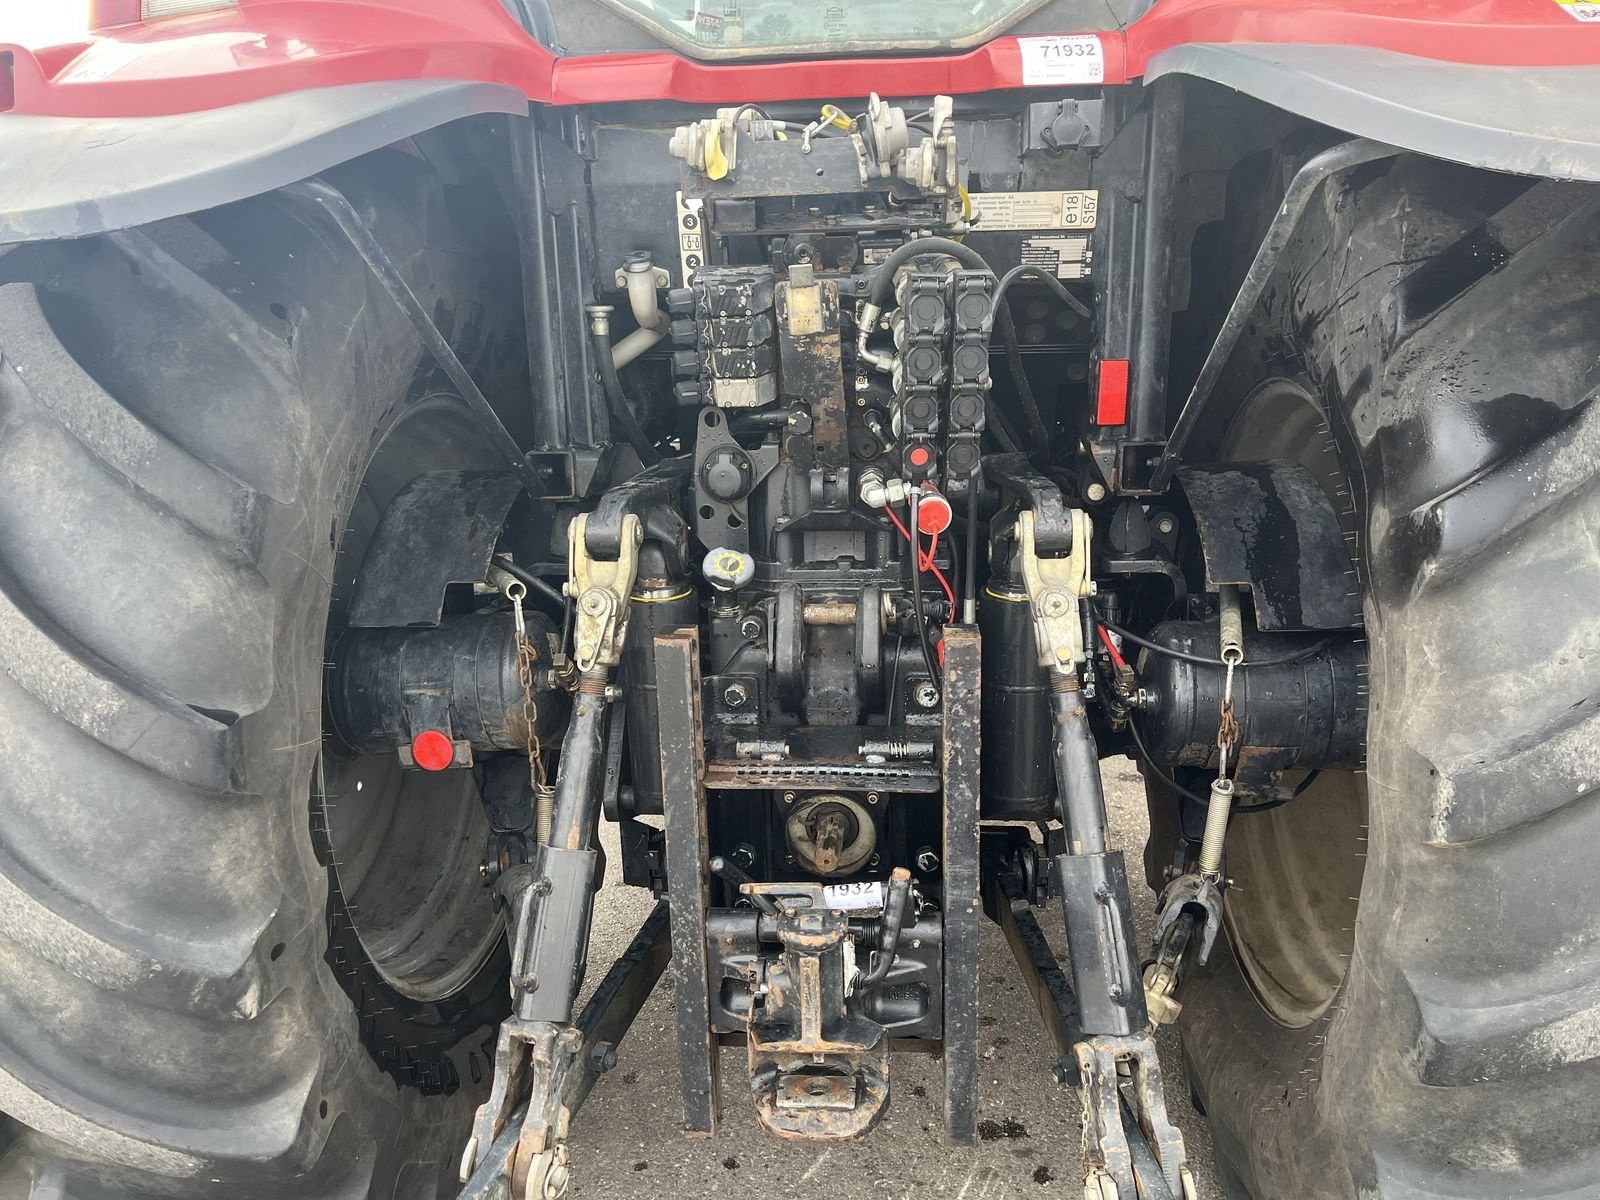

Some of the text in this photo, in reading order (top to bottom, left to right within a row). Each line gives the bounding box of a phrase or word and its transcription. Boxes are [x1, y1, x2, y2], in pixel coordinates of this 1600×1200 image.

[1040, 44, 1096, 57] 71932
[1065, 195, 1078, 224] e18
[1083, 195, 1096, 224] S157
[687, 217, 694, 226] 3
[690, 257, 697, 266] 2
